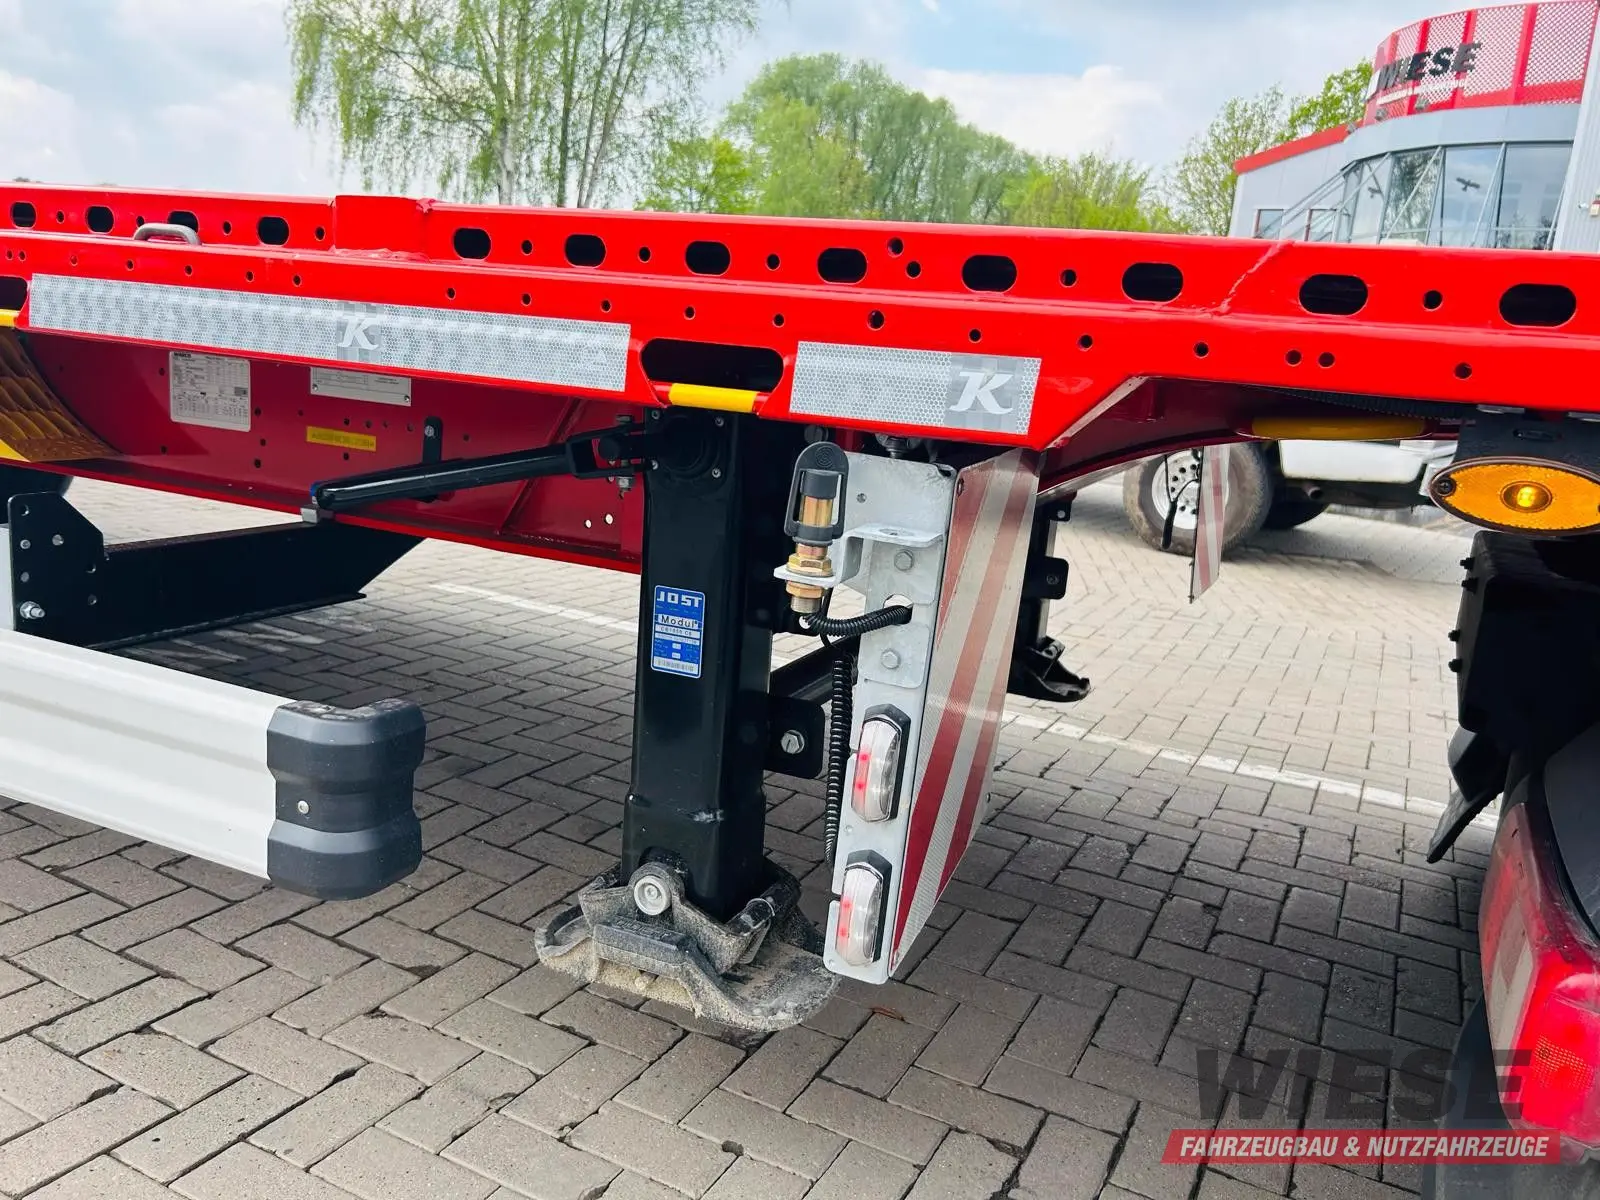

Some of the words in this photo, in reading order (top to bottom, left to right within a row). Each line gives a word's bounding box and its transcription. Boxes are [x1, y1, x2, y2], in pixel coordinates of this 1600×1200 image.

[1377, 41, 1482, 91] WIESE
[337, 314, 380, 350] K
[949, 371, 1014, 414] K
[656, 590, 703, 608] JOST
